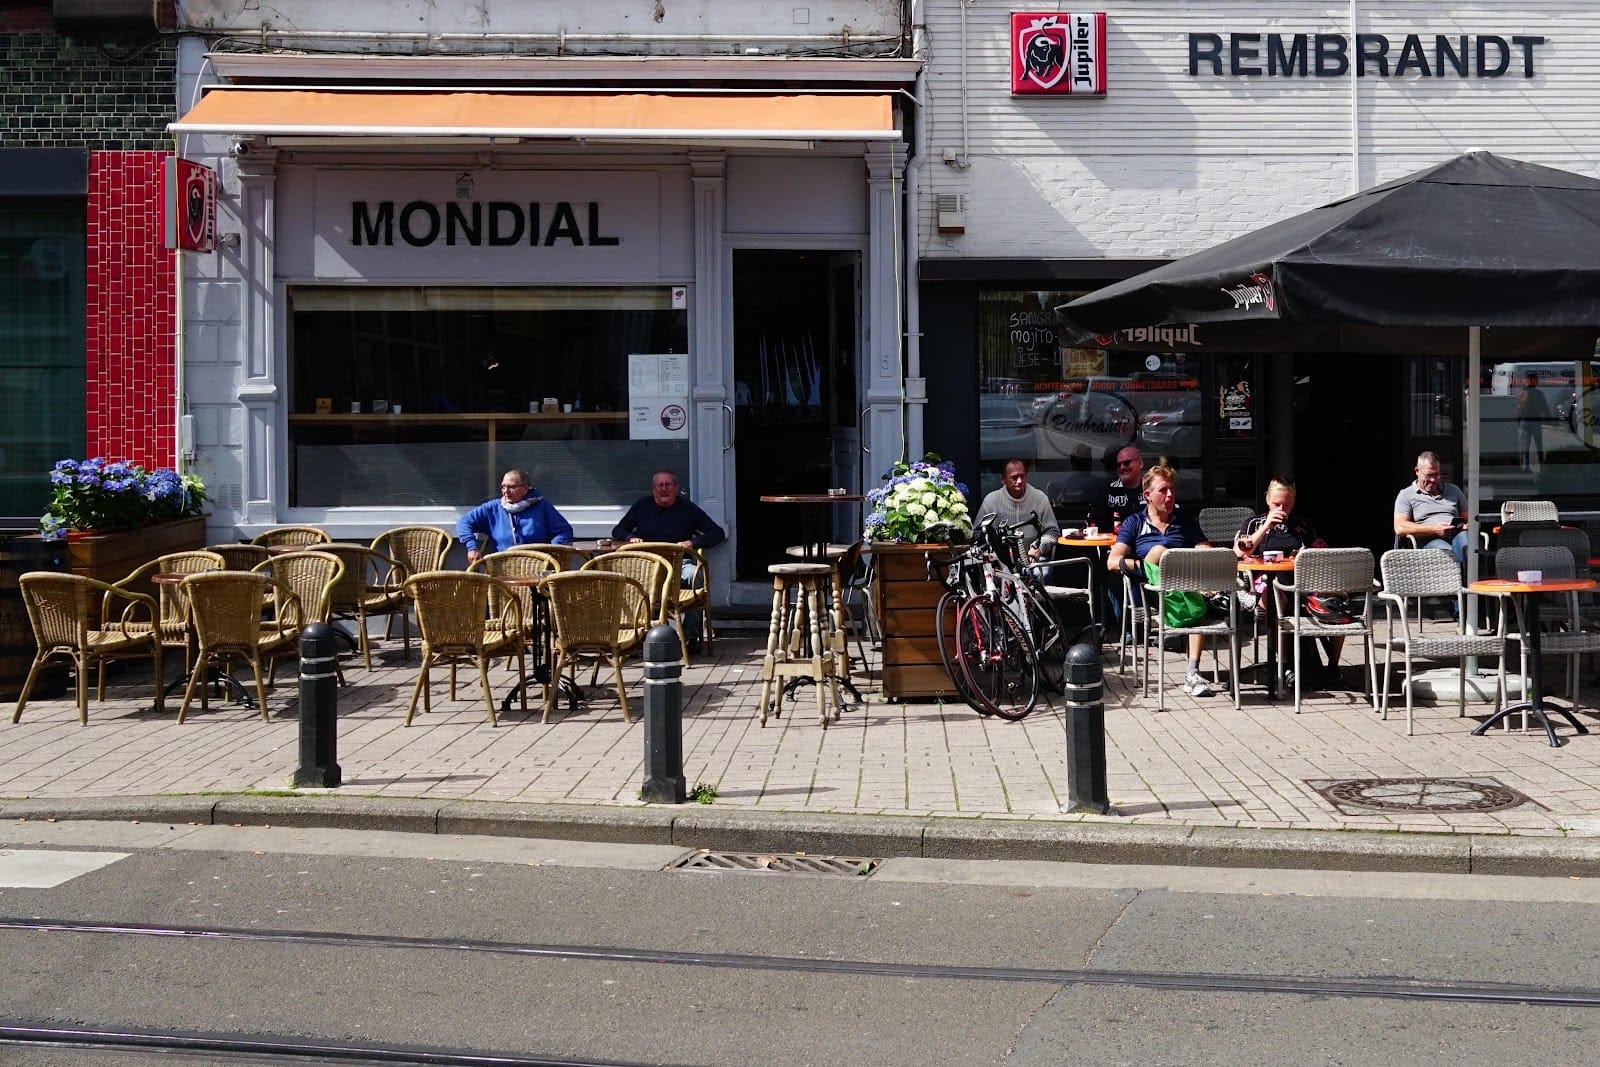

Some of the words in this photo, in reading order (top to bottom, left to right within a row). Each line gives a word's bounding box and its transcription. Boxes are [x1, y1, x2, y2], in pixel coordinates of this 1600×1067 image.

[1074, 16, 1094, 88] Jupiler
[1188, 32, 1546, 79] REMBRANDT
[352, 201, 620, 247] MONDIAL
[1220, 283, 1264, 312] Jupiler
[1008, 311, 1058, 328] SANGRI
[1051, 413, 1130, 434] Rembrandt
